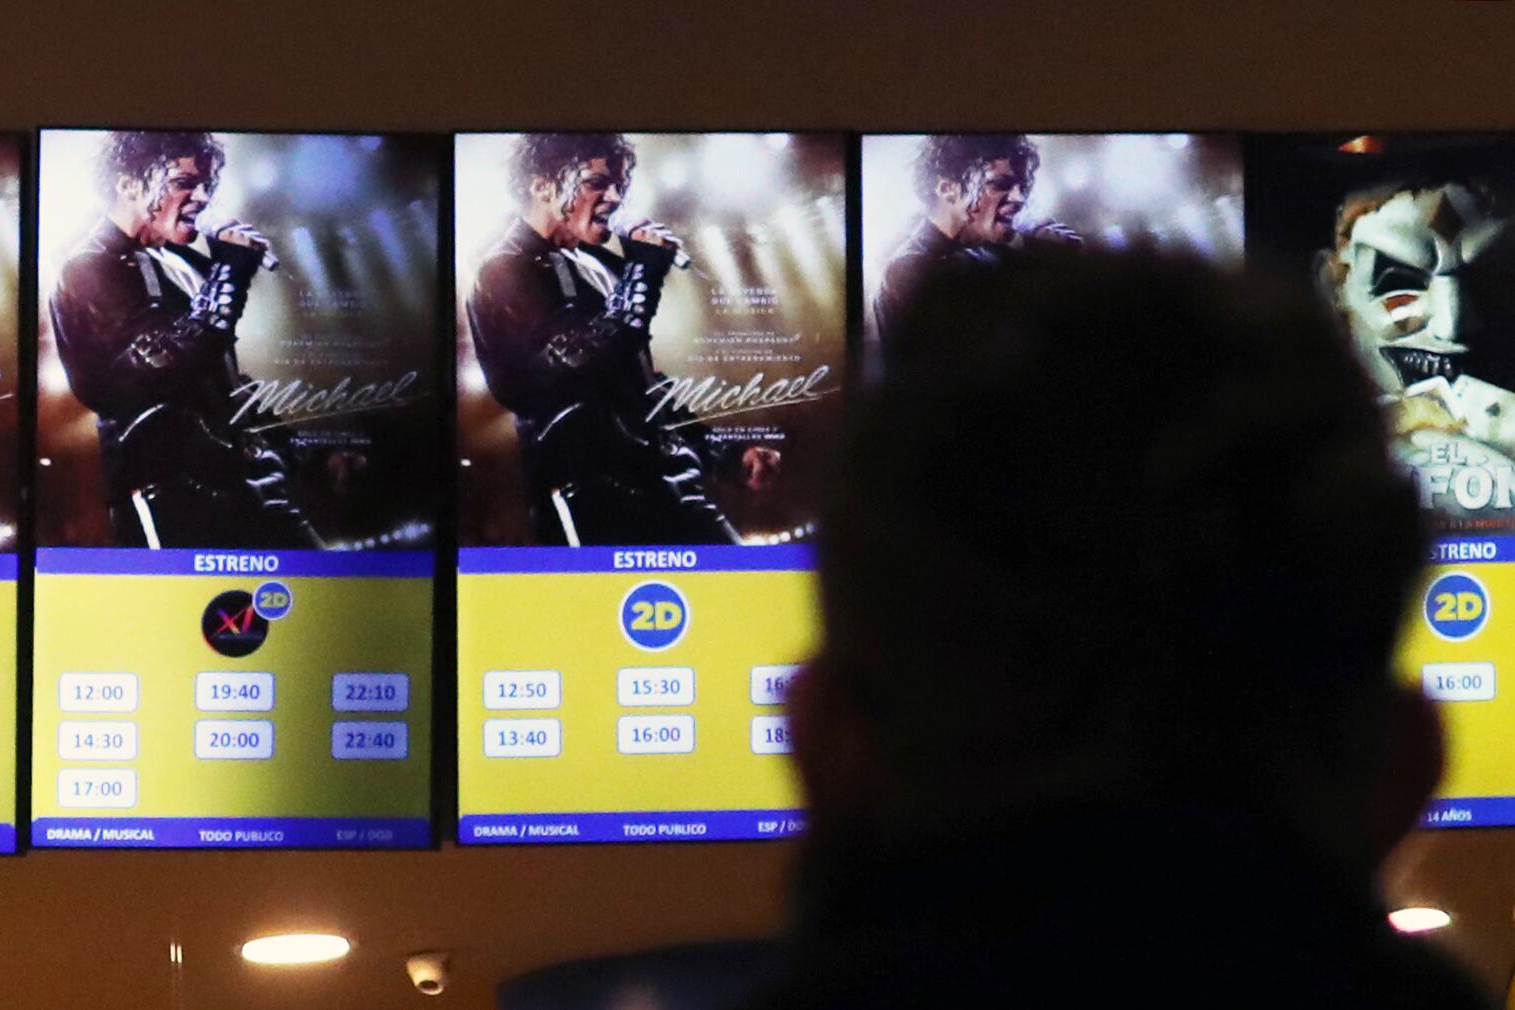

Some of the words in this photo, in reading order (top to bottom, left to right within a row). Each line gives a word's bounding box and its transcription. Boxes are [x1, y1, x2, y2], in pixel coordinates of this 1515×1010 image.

[229, 371, 430, 426] Michael
[644, 364, 840, 423] Michael
[1431, 441, 1468, 465] EL
[1431, 541, 1497, 561] TRENO
[194, 554, 279, 573] ESTRENO
[613, 551, 697, 569] ESTRENO
[259, 592, 289, 608] 2D
[1434, 592, 1483, 621] 2D
[631, 601, 683, 631] 2D
[497, 682, 547, 698] 12:50
[632, 679, 681, 695] 15:30
[764, 677, 791, 693] 16:
[1435, 675, 1482, 690] 16:00
[73, 685, 124, 701] 12:00
[210, 684, 260, 700] 19:40
[345, 685, 396, 701] 22:10
[73, 733, 124, 749] 14:30
[209, 732, 259, 748] 20:00
[344, 733, 395, 749] 22:40
[497, 730, 547, 746] 13:40
[632, 727, 681, 743] 16:00
[764, 727, 791, 744] 18:
[72, 781, 123, 797] 17:00
[1427, 811, 1440, 822] 14
[1441, 807, 1473, 822] AÑOS
[46, 829, 92, 841] DRAMA
[102, 829, 155, 841] MUSICAL
[199, 830, 233, 842] TODO
[235, 830, 284, 842] PUBLICO
[474, 825, 518, 838] DRAMA
[528, 825, 579, 837] MUSICAL
[623, 824, 656, 836] TODO
[658, 823, 707, 836] PUBLICO
[758, 821, 778, 833] ESP
